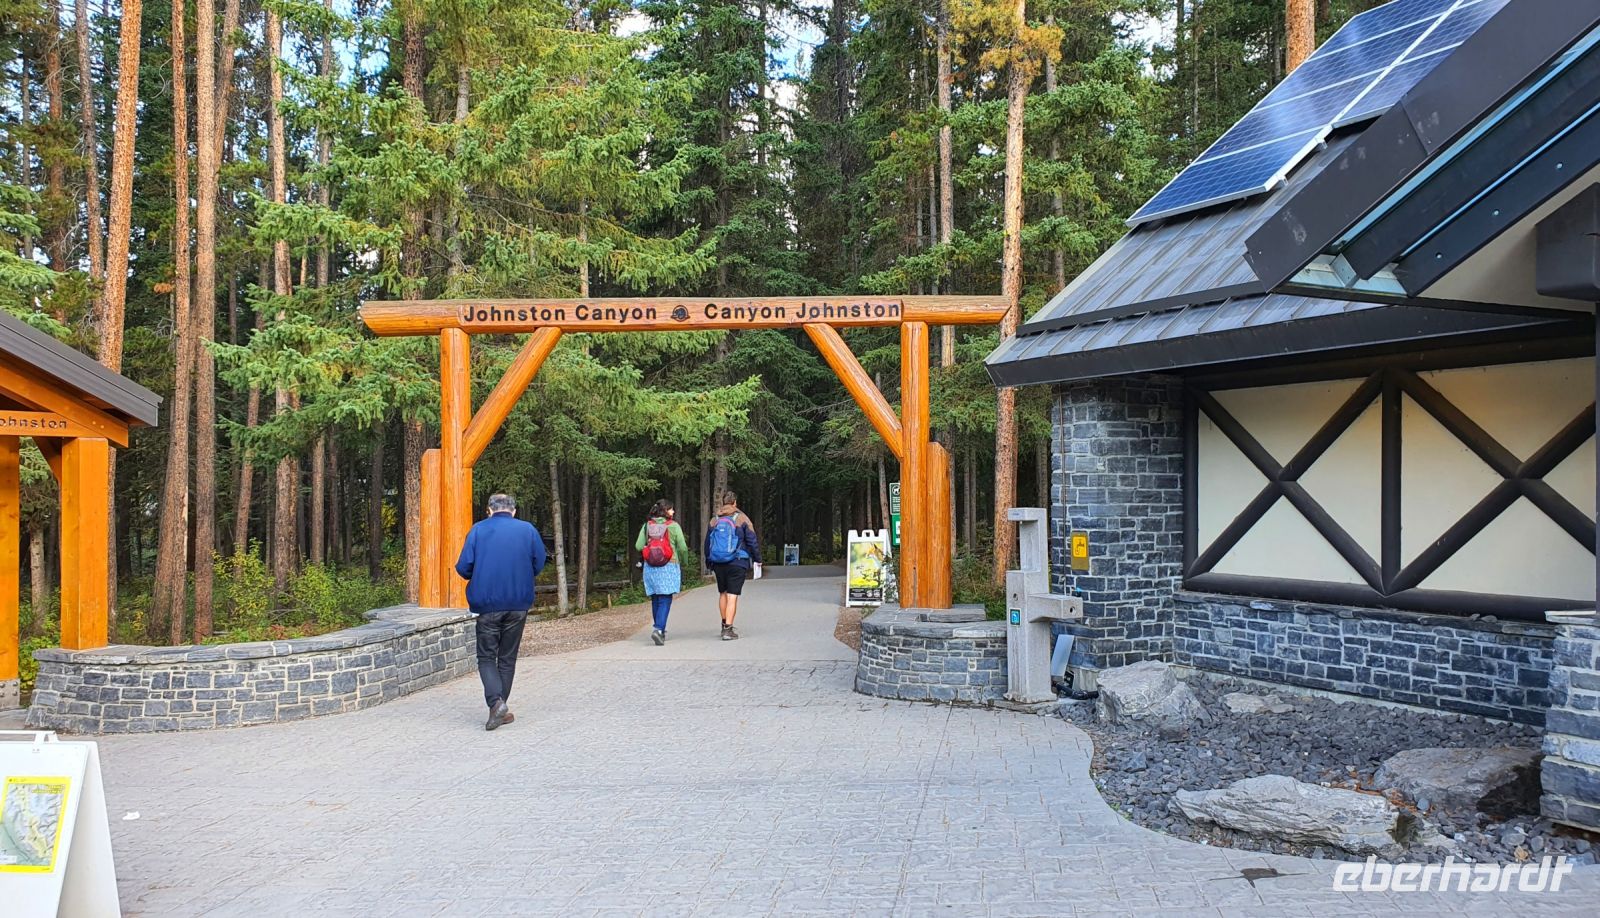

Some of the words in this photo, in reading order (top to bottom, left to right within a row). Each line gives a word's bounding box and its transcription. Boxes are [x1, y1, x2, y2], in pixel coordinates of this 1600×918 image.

[464, 306, 566, 322] Johnston
[575, 304, 657, 323] Canyon
[704, 303, 786, 322] Canyon
[796, 302, 900, 319] Johnston
